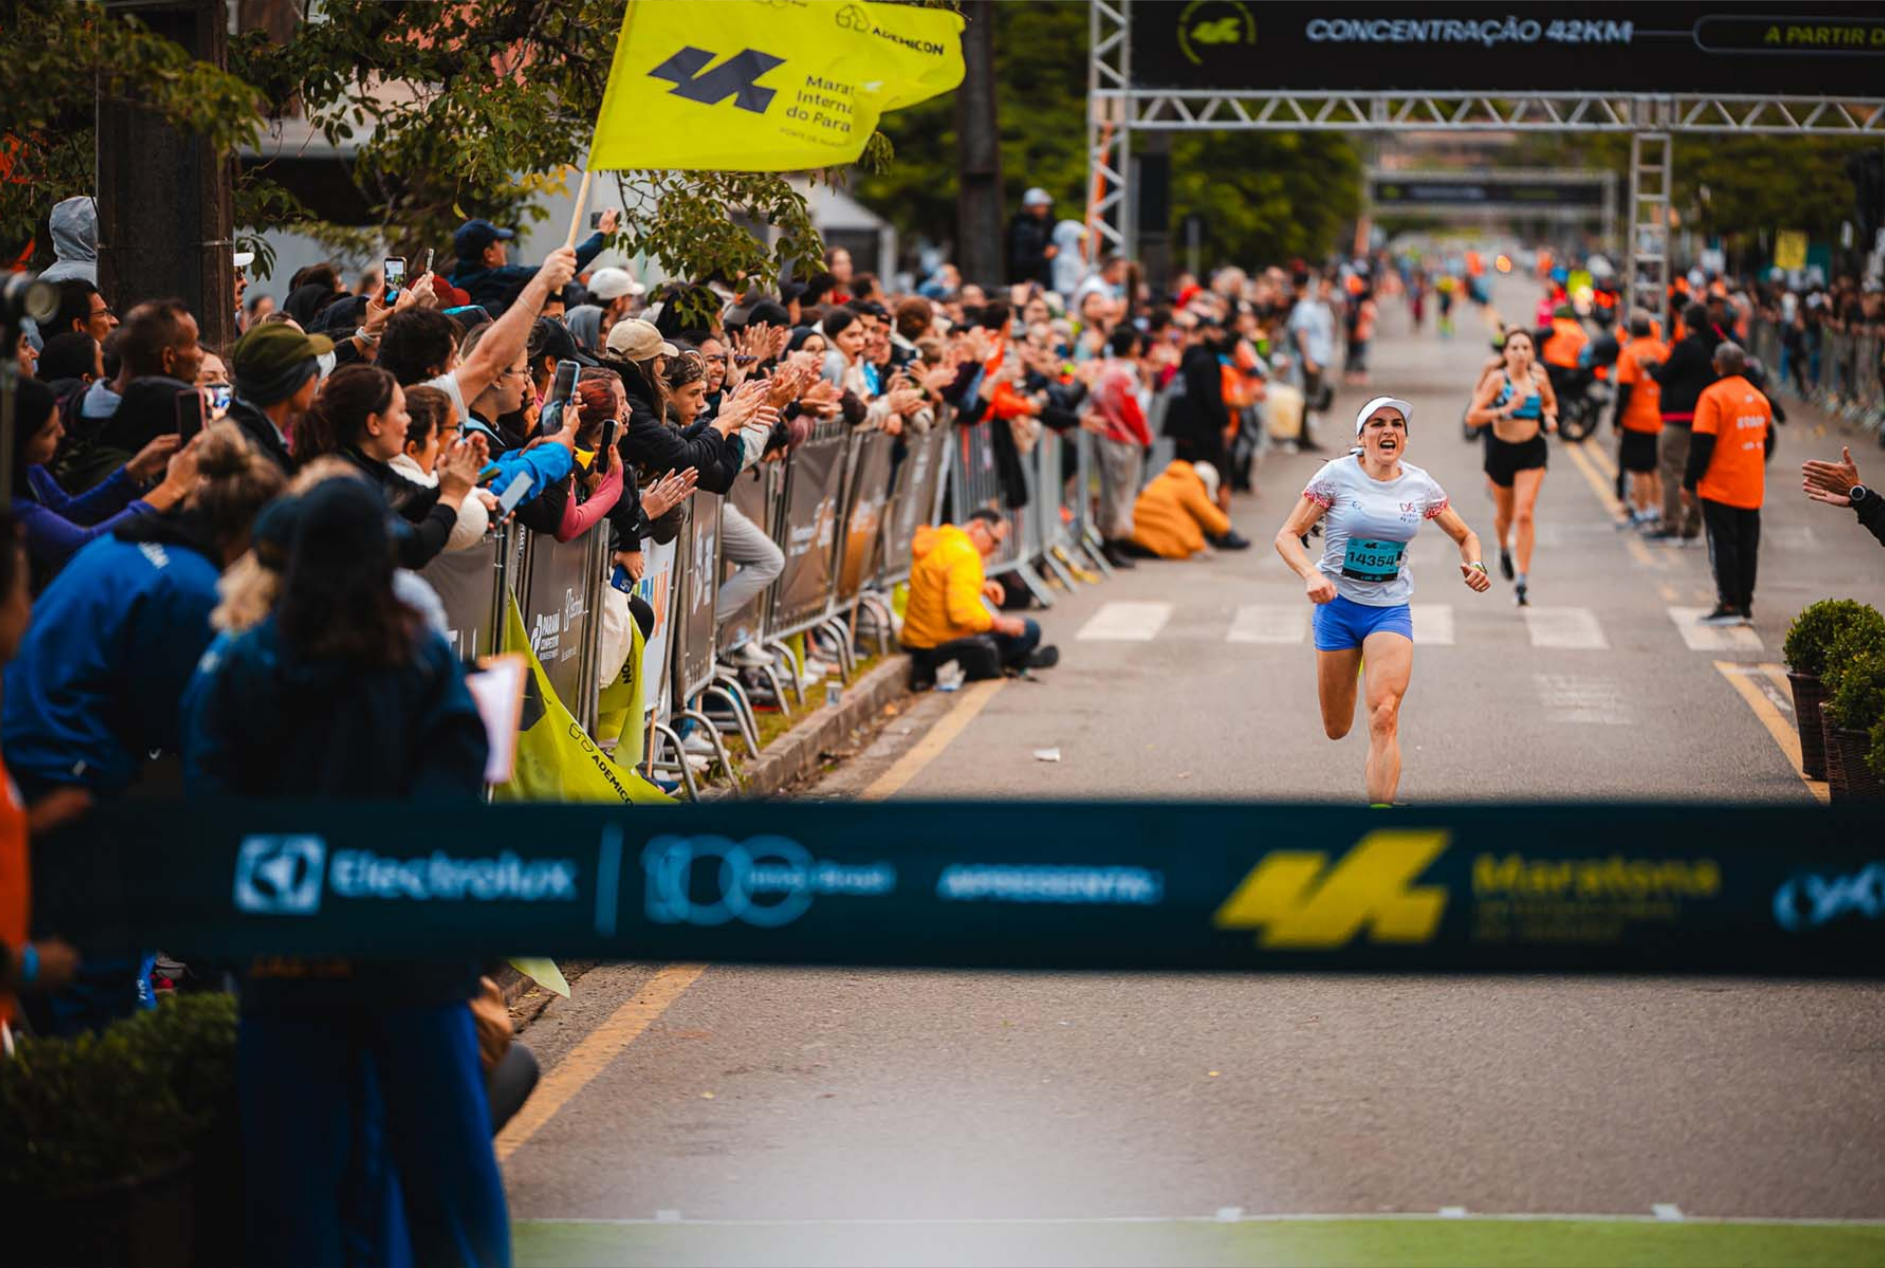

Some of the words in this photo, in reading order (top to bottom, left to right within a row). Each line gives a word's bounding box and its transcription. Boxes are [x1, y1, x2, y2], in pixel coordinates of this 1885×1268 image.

[1305, 15, 1541, 47] CONCENTRAÇÃO
[1545, 19, 1634, 43] 42KM
[1764, 25, 1781, 43] A
[1785, 26, 1865, 44] PARTIR
[786, 106, 809, 121] do
[813, 111, 852, 133] Para
[1348, 551, 1394, 567] 14354
[329, 848, 578, 899] Electrolux
[1472, 852, 1721, 897] Maratona
